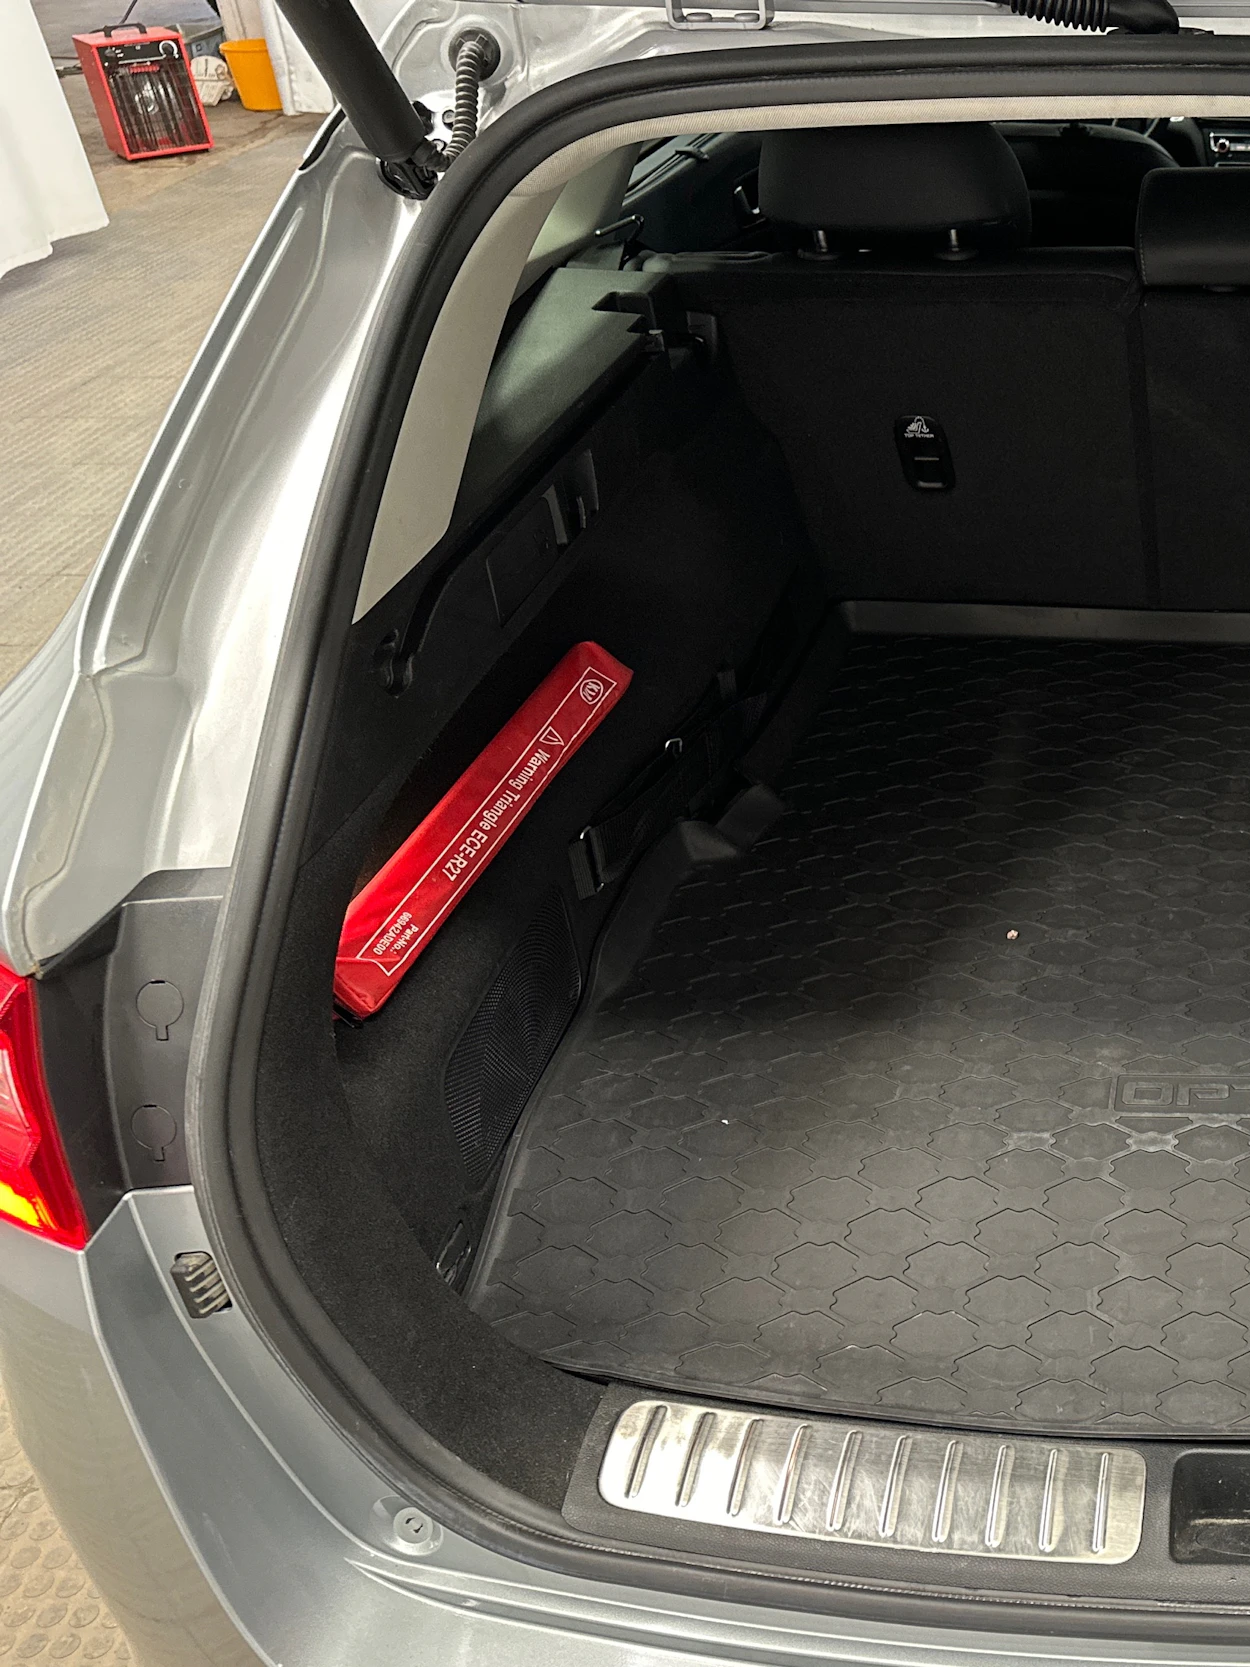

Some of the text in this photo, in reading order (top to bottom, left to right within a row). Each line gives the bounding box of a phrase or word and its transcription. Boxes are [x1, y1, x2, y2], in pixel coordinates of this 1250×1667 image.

[442, 748, 551, 881] Warning Triangle ECE-R27
[373, 912, 413, 956] 66942ADE00
[390, 923, 419, 954] Part-No.:
